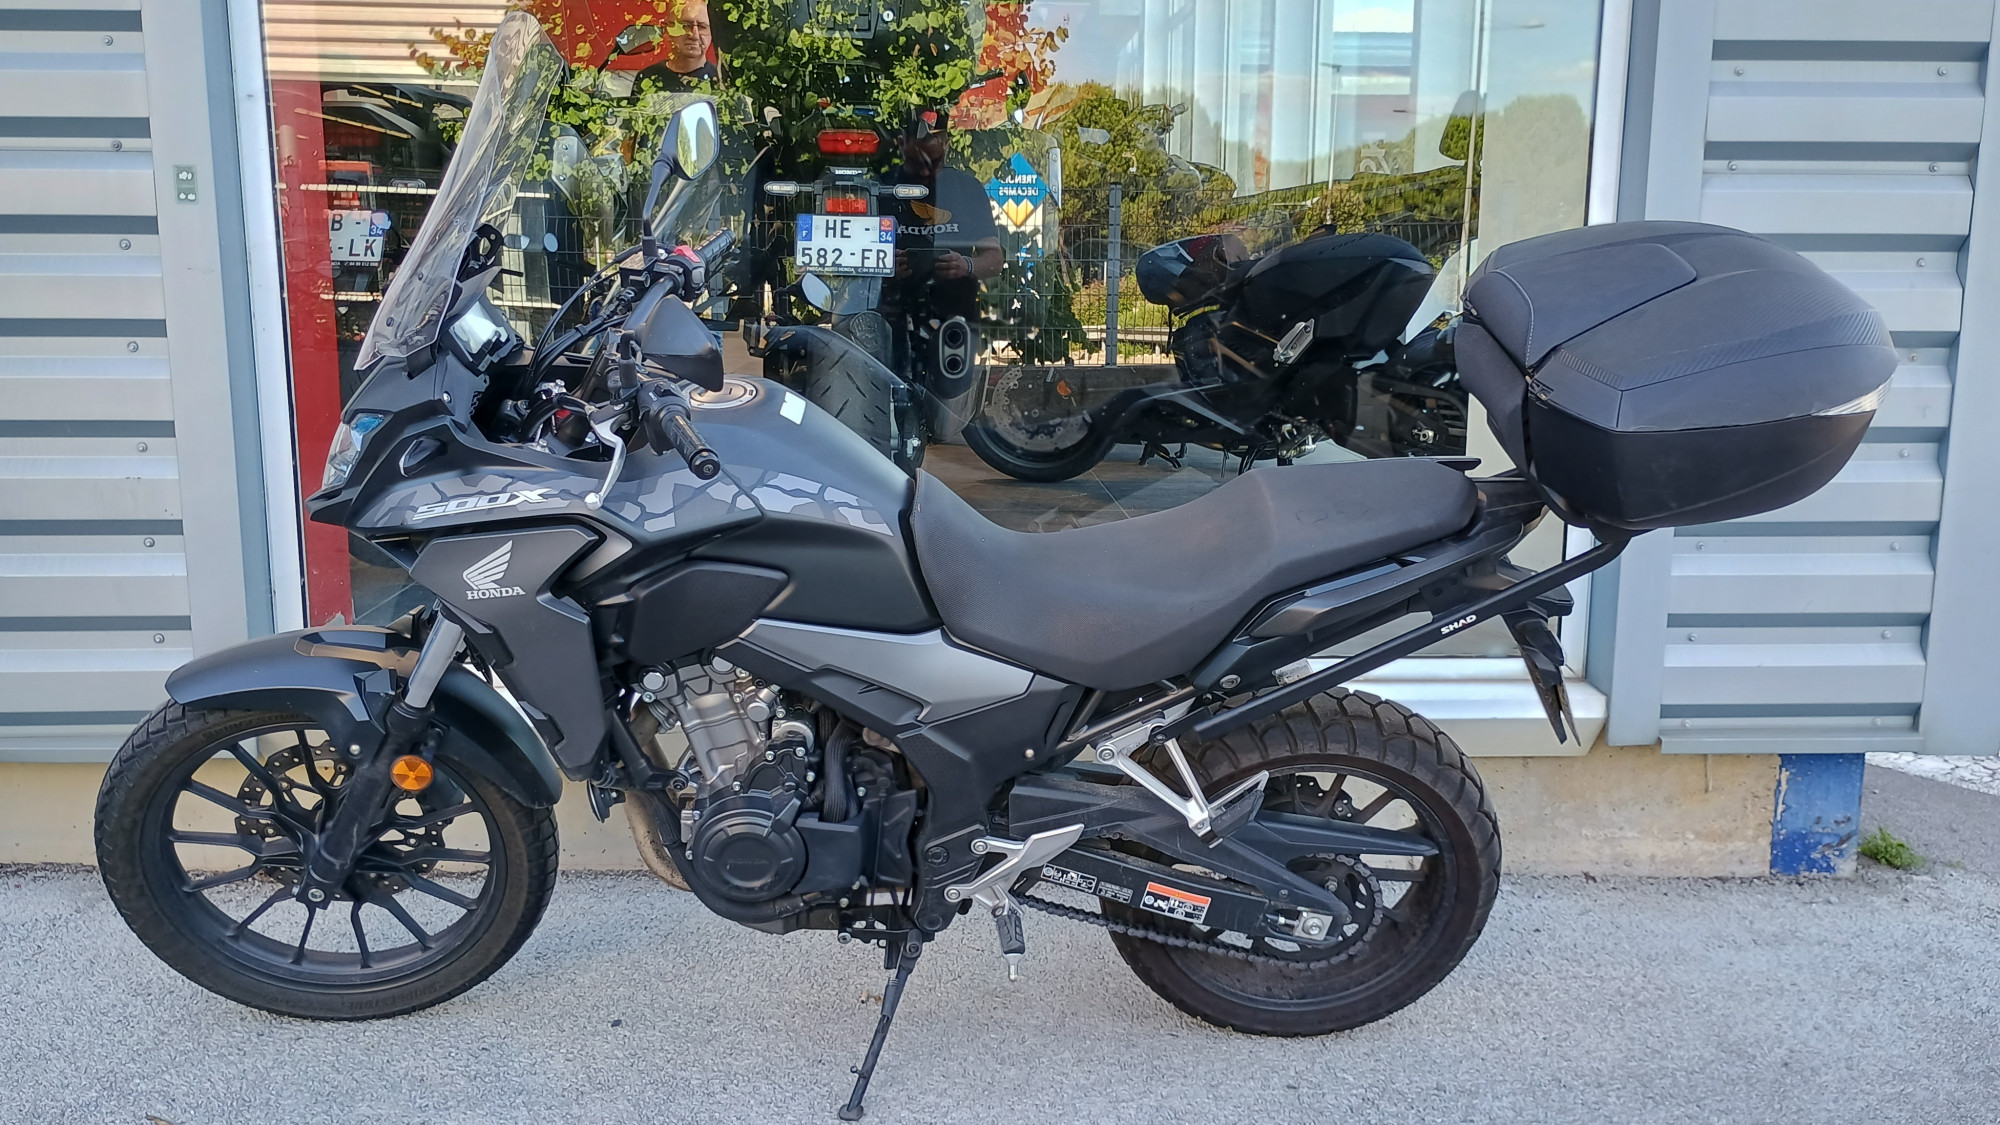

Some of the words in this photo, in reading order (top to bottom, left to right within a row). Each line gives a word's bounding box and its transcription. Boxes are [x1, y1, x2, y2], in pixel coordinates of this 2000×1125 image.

[331, 213, 343, 231] B
[370, 225, 382, 235] 34
[880, 231, 892, 242] 34
[413, 489, 552, 519] 500X
[466, 586, 526, 600] HONDA
[1440, 614, 1477, 635] SHAD
